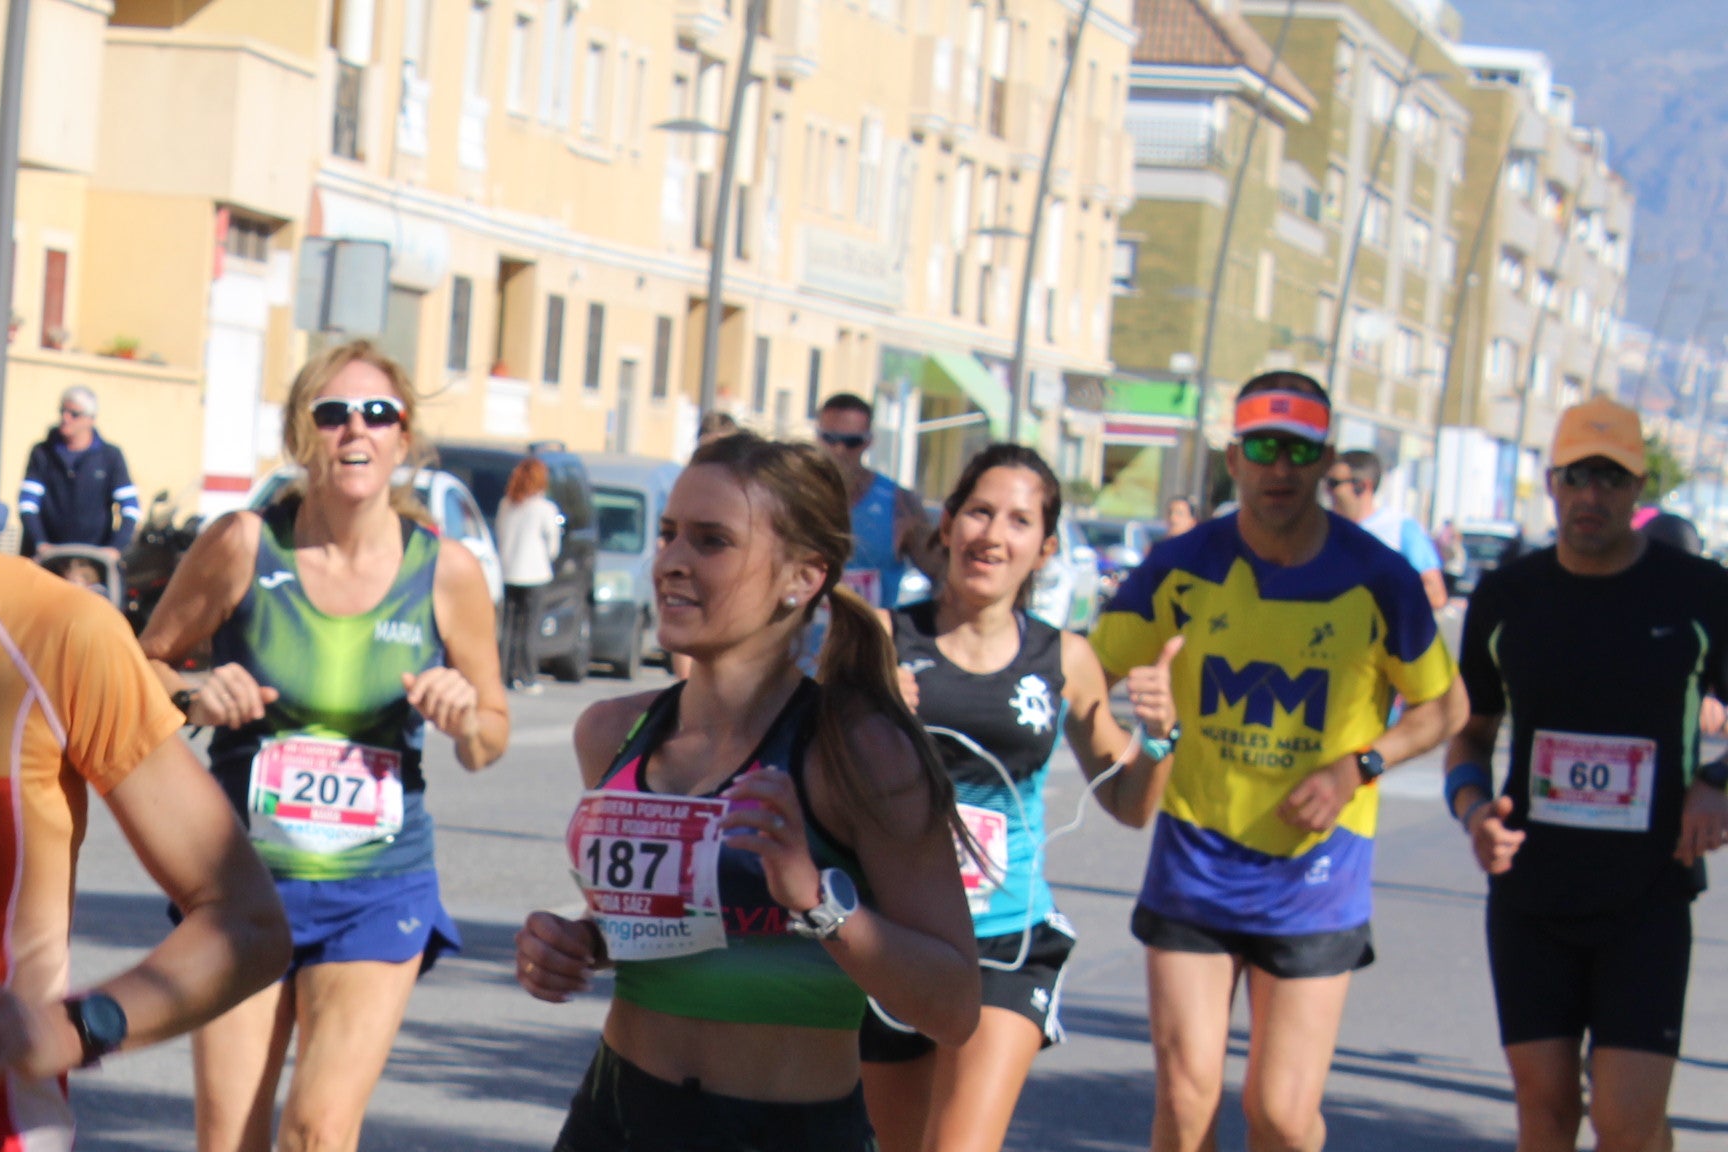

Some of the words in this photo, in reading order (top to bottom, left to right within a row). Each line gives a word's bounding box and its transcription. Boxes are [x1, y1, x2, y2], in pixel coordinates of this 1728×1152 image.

[1202, 727, 1268, 748] MUEBLES
[292, 771, 365, 807] 207
[1569, 761, 1610, 791] 60
[587, 837, 669, 891] 187
